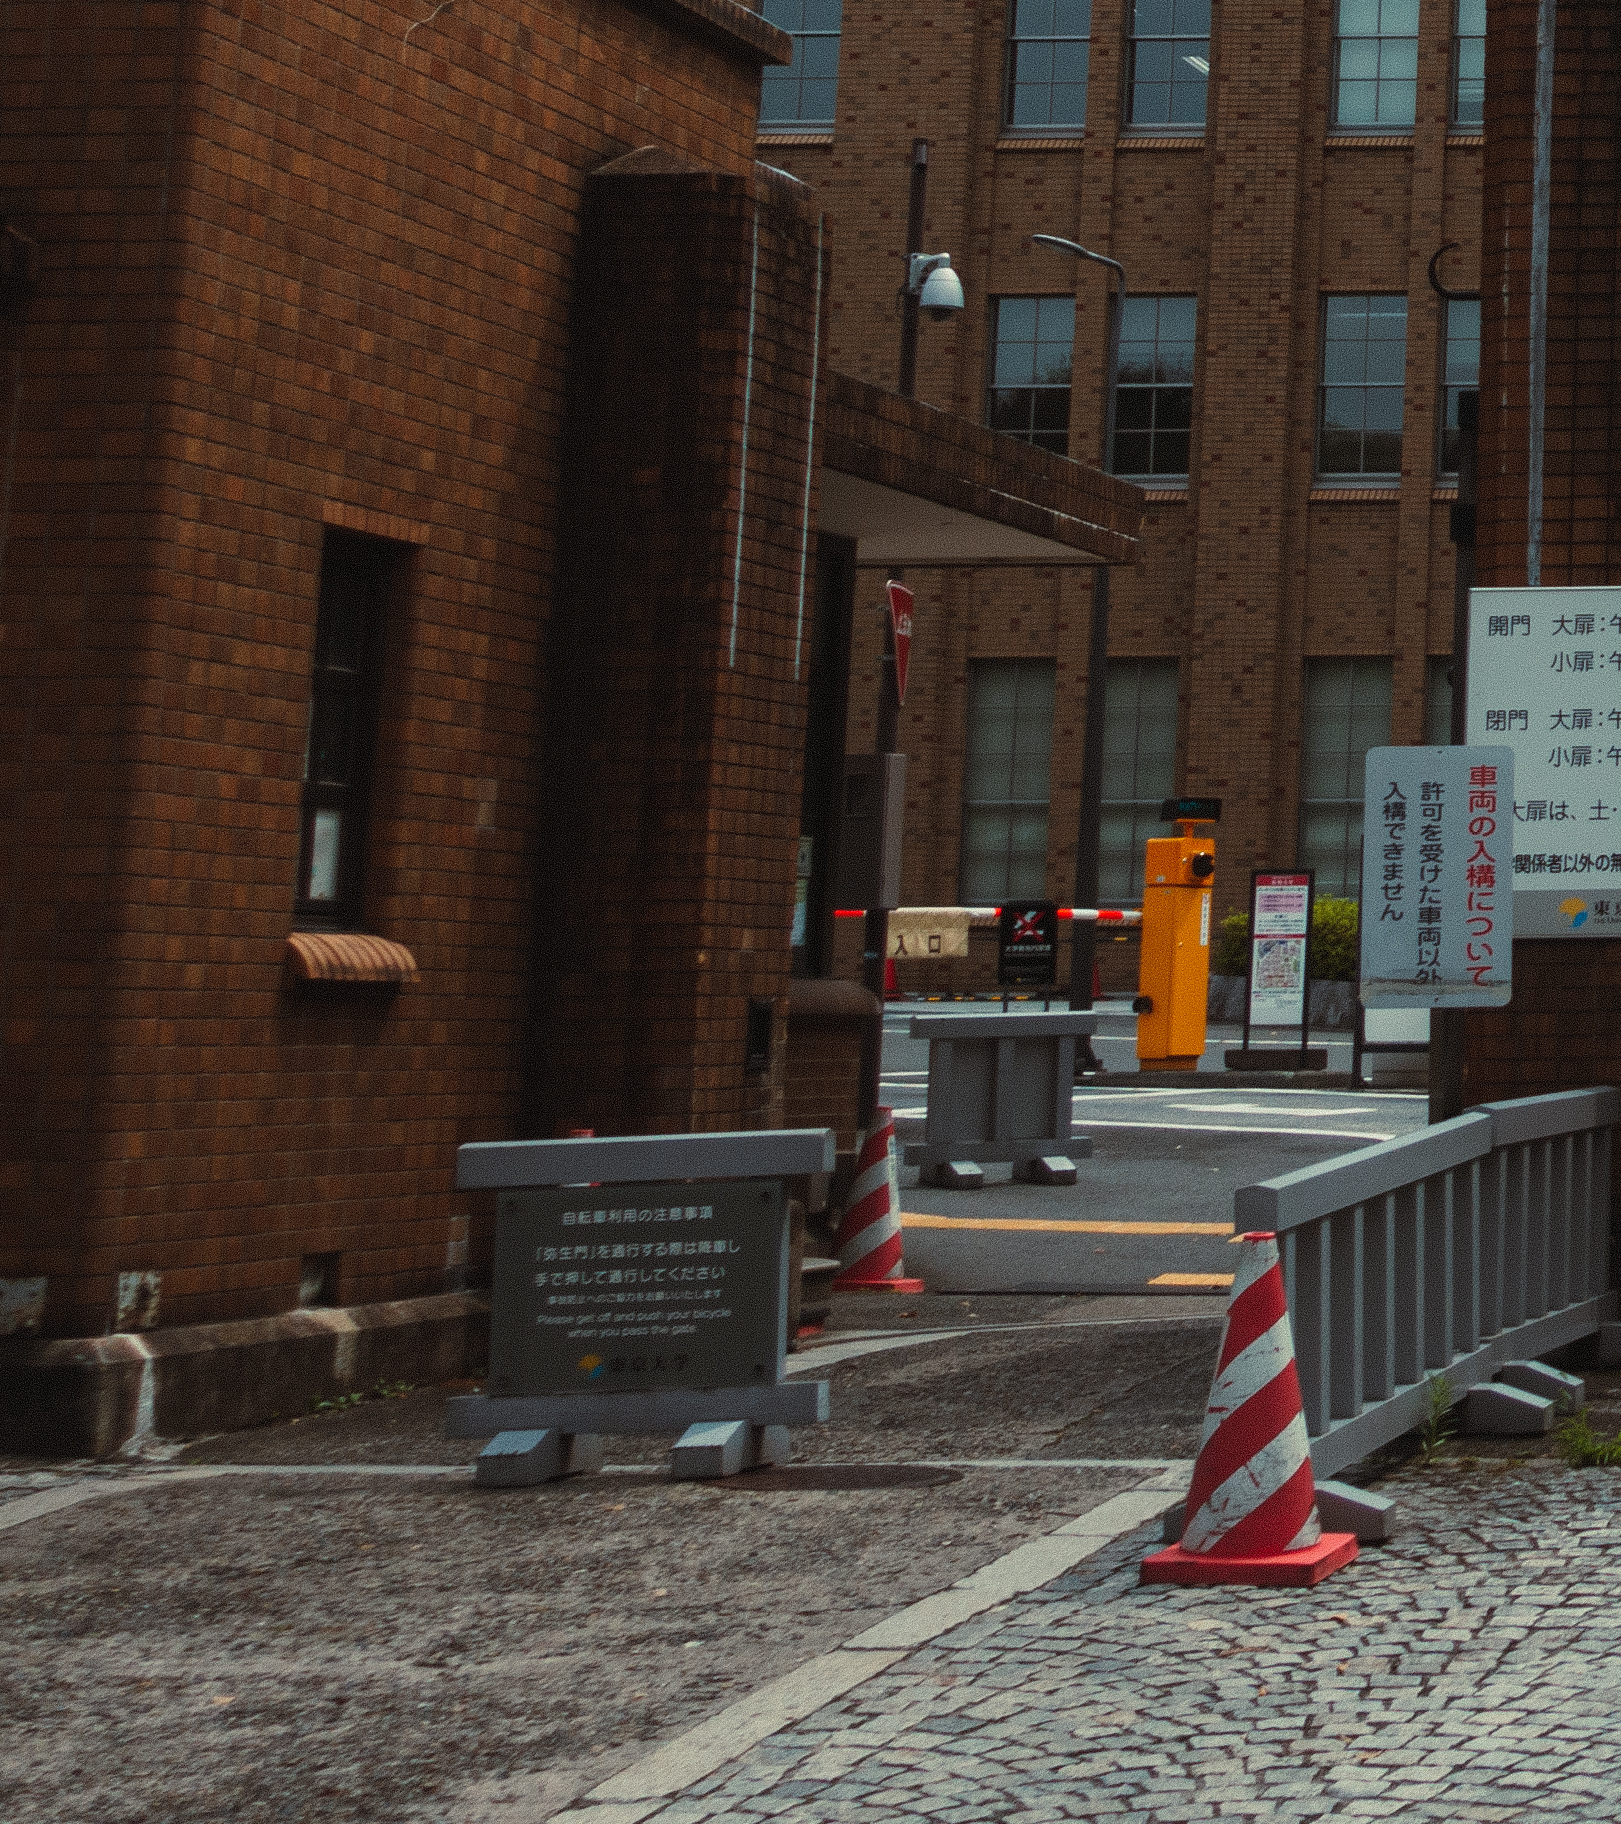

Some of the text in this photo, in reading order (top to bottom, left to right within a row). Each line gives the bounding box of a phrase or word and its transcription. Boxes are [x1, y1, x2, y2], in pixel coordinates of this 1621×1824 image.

[1488, 614, 1532, 637] 開門
[1485, 709, 1529, 732] 閉門
[1380, 781, 1408, 922] 入構できません
[1416, 781, 1445, 984] 許可を受けた車両以外
[1465, 764, 1498, 987] 車両の入構について
[894, 934, 941, 955] 入口
[563, 1205, 713, 1226] 自転車利用の注意事項
[534, 1267, 725, 1287] 手で押して通行してください
[536, 1313, 574, 1325] Please
[576, 1313, 595, 1325] get
[613, 1311, 635, 1323] and
[666, 1310, 691, 1322] your
[693, 1307, 732, 1320] bicycle
[567, 1328, 598, 1338] when
[599, 1328, 620, 1339] you
[621, 1327, 649, 1338] pass
[651, 1324, 669, 1335] the
